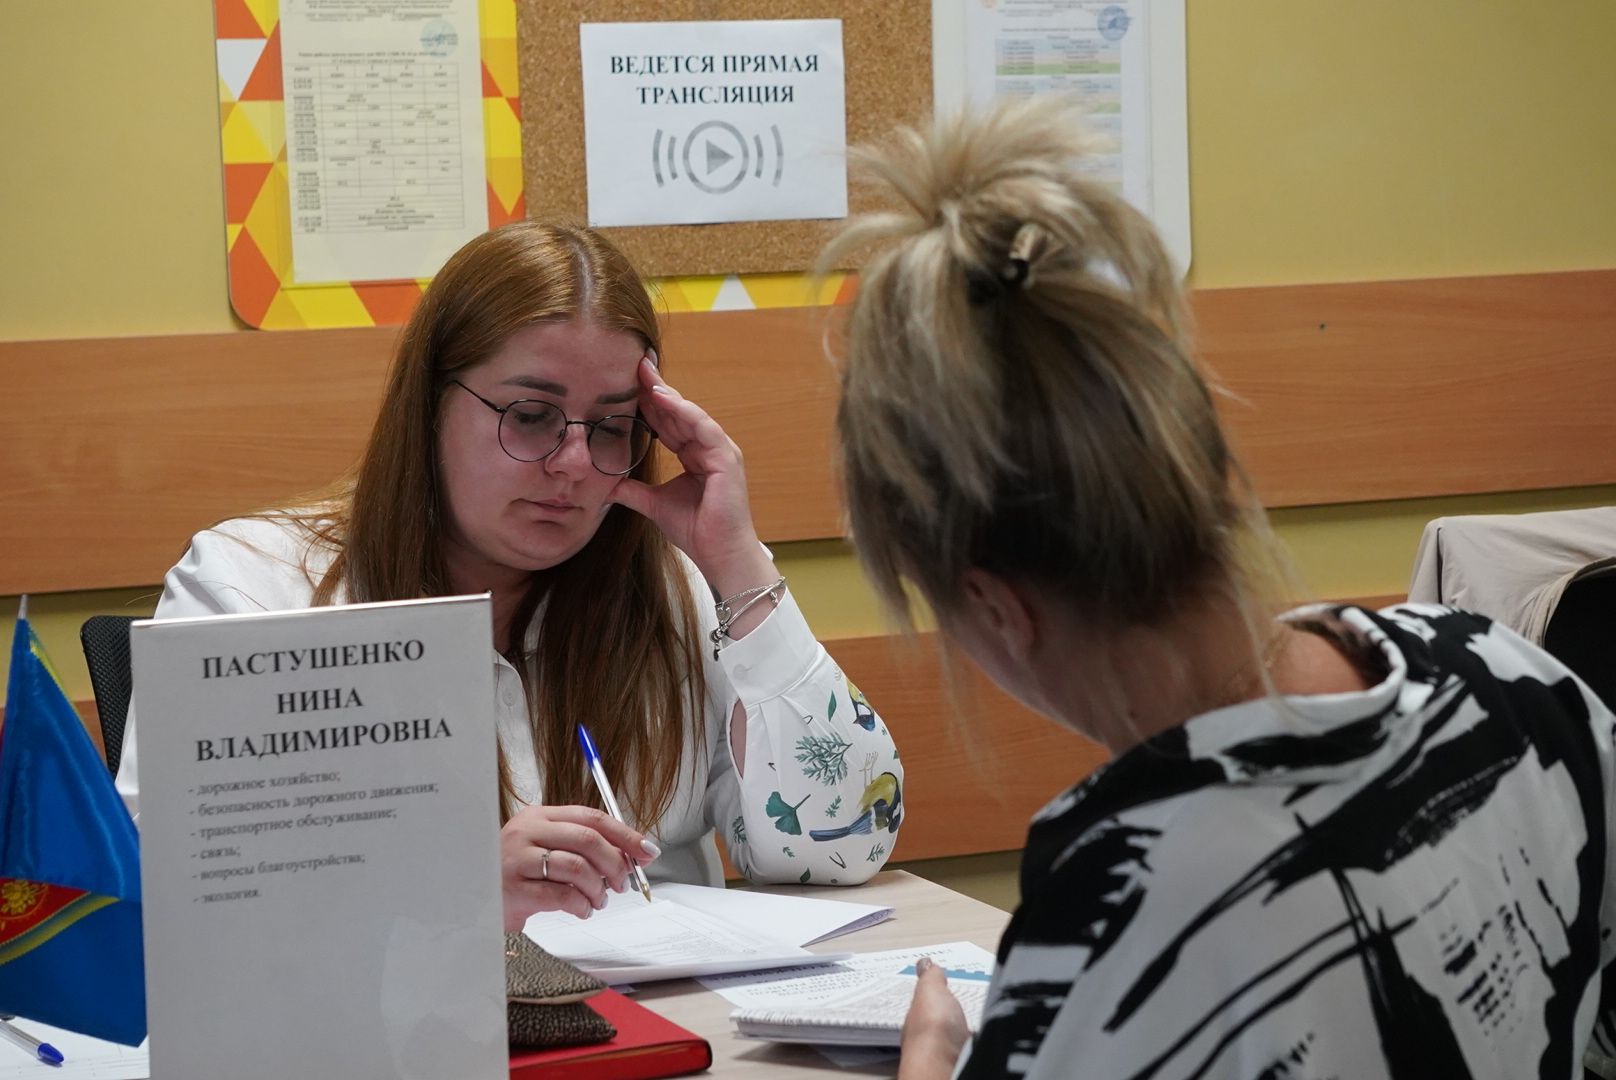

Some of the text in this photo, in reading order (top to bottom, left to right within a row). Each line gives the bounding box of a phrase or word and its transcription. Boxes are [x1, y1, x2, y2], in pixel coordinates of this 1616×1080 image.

[611, 54, 819, 76] ВЕДЕТСЯ ПРЯМАЯ
[636, 84, 795, 106] ТРАНСЛЯЦИЯ
[202, 639, 425, 679] ПАСТУШЕНКО
[277, 687, 364, 714] НИНА
[196, 718, 452, 762] ВЛАДИМИРОВНА
[197, 778, 266, 796] дорожное
[269, 771, 341, 787] хозяйство;
[198, 799, 290, 817] безопасность
[293, 791, 366, 808] дорожного
[370, 782, 440, 800] движения;
[199, 820, 293, 840] транспортное
[296, 808, 397, 828] обслуживание;
[200, 845, 241, 859] связь;
[200, 865, 254, 881] вопросы
[258, 852, 366, 874] благоустройства;
